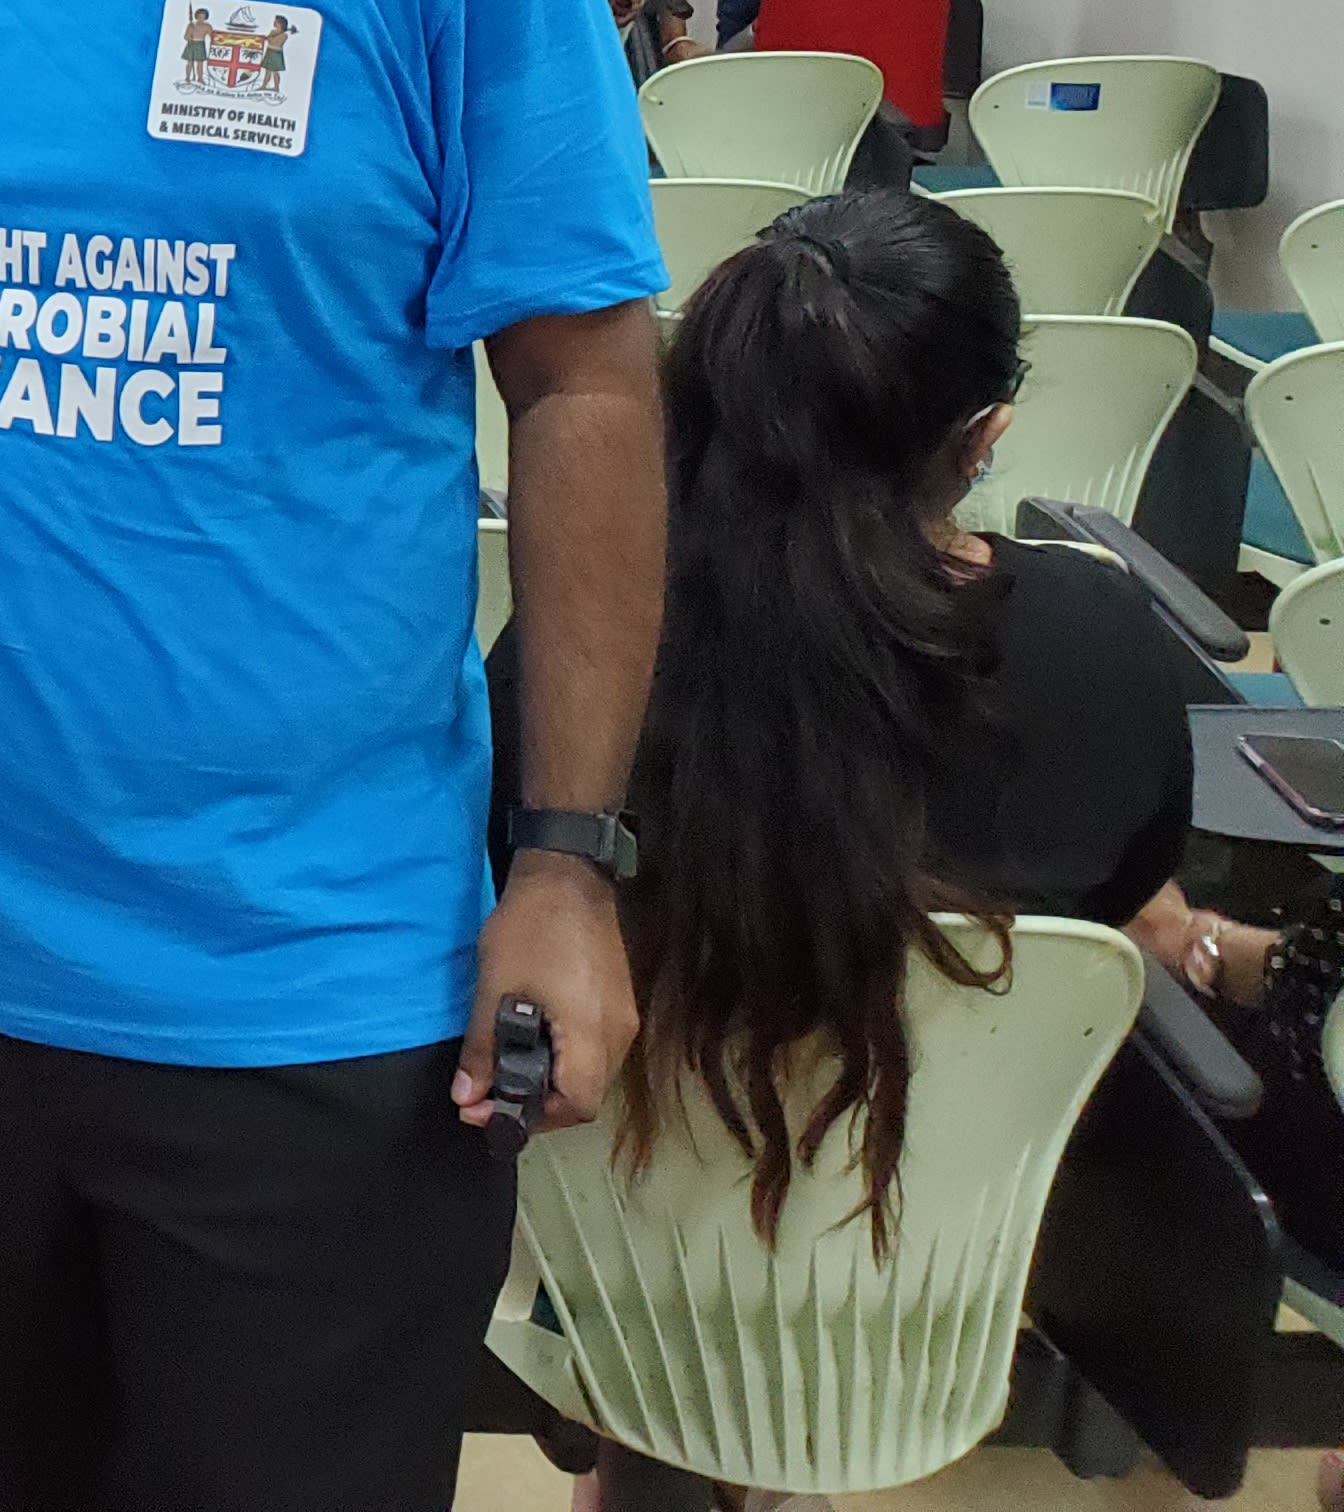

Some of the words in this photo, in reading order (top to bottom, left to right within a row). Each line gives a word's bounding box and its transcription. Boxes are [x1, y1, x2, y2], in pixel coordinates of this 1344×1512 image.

[161, 102, 226, 120] MINISTRY
[227, 110, 244, 122] OF
[247, 113, 297, 131] HEALTH
[159, 121, 168, 133] &
[172, 122, 230, 139] MEDICAL
[232, 129, 293, 149] SERVICES
[55, 234, 236, 297] AGAINST
